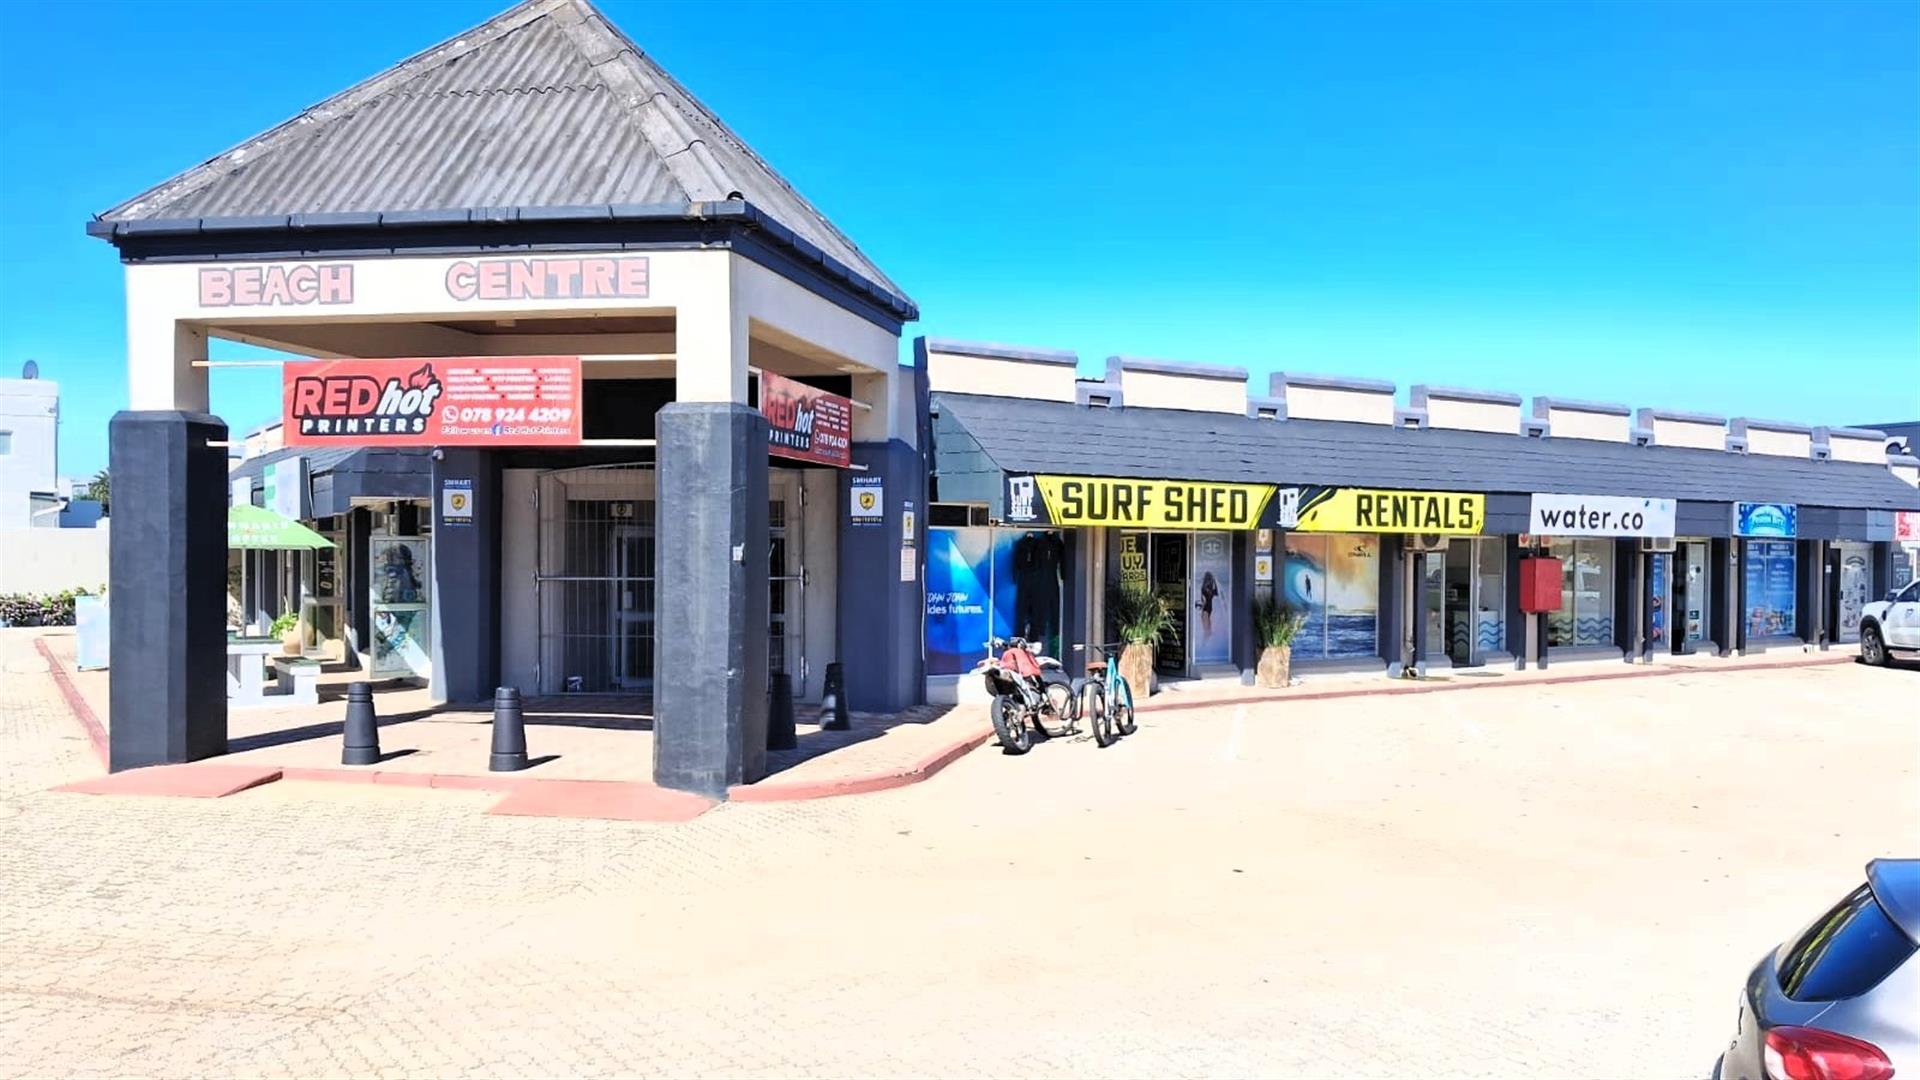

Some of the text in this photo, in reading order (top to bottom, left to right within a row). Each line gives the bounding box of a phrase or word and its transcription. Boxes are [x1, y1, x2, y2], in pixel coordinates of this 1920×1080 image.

[199, 257, 650, 307] BEACH CENTRE
[302, 417, 426, 434] PRINTERS
[461, 407, 571, 421] 078 924 4209
[769, 429, 809, 449] PRINTERS
[1062, 482, 1153, 520] SURF
[1164, 486, 1248, 523] SHED
[1356, 494, 1474, 529] RENTALS
[1540, 504, 1644, 530] water.co
[927, 604, 947, 615] ides
